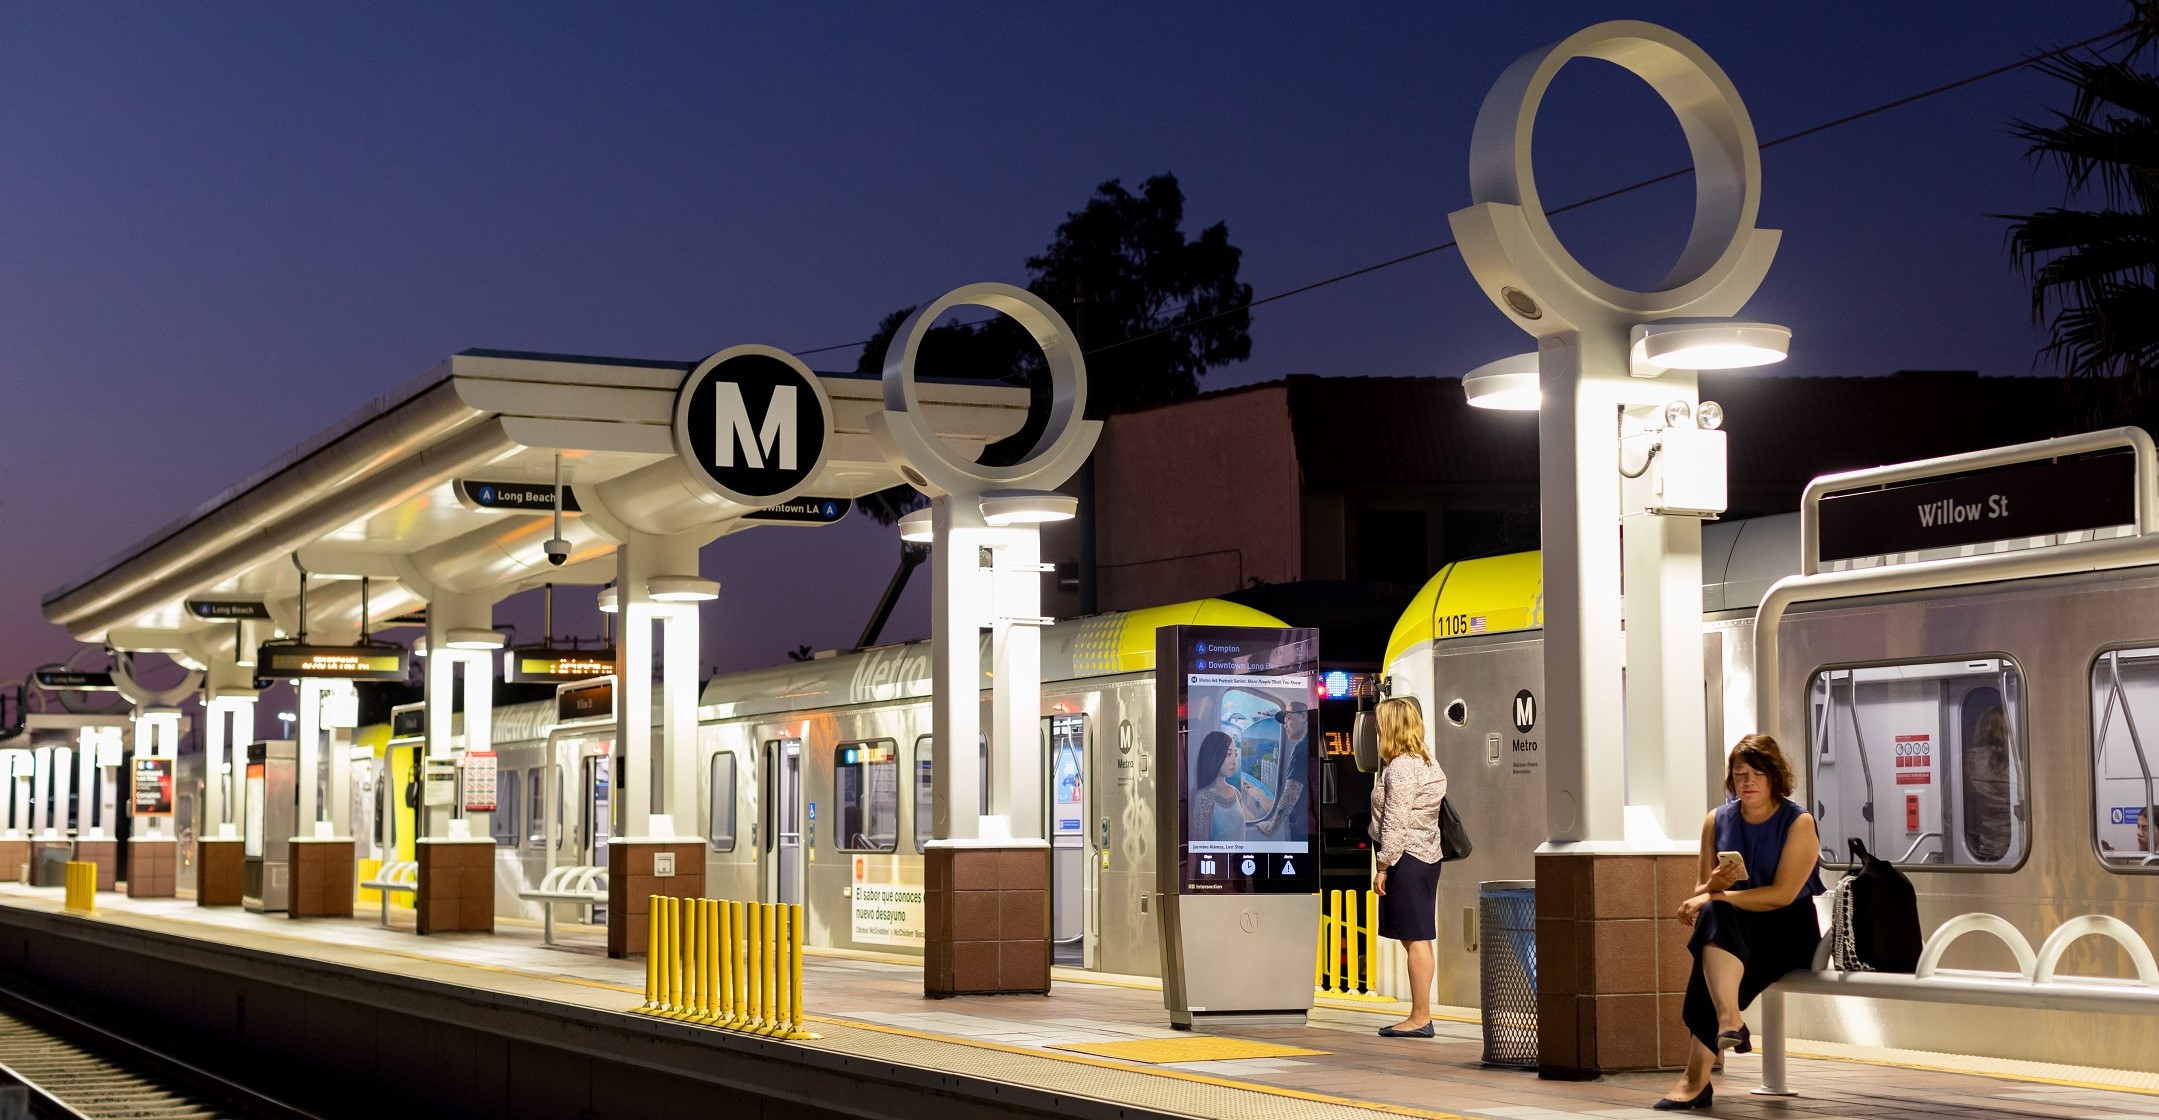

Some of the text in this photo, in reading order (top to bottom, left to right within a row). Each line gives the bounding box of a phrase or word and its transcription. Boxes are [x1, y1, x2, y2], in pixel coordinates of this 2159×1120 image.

[716, 381, 797, 471] M
[483, 490, 555, 503] A Long Beach
[762, 503, 834, 515] owntown LA A
[1917, 494, 2009, 528] Willow St
[212, 605, 230, 615] Long
[232, 605, 254, 615] Beach
[1438, 614, 1467, 637] 1105
[1208, 644, 1240, 653] Compton
[1208, 661, 1246, 669] Downtown
[1248, 663, 1264, 671] Long
[849, 649, 927, 703] Metro
[1516, 696, 1533, 726] M
[1120, 725, 1131, 749] M
[1512, 739, 1538, 752] Metro
[1117, 758, 1134, 768] Metro
[856, 887, 862, 901] El
[863, 887, 880, 901] sabor
[882, 891, 893, 906] que
[895, 891, 922, 904] conoces
[856, 906, 906, 925] nuevo desayuno
